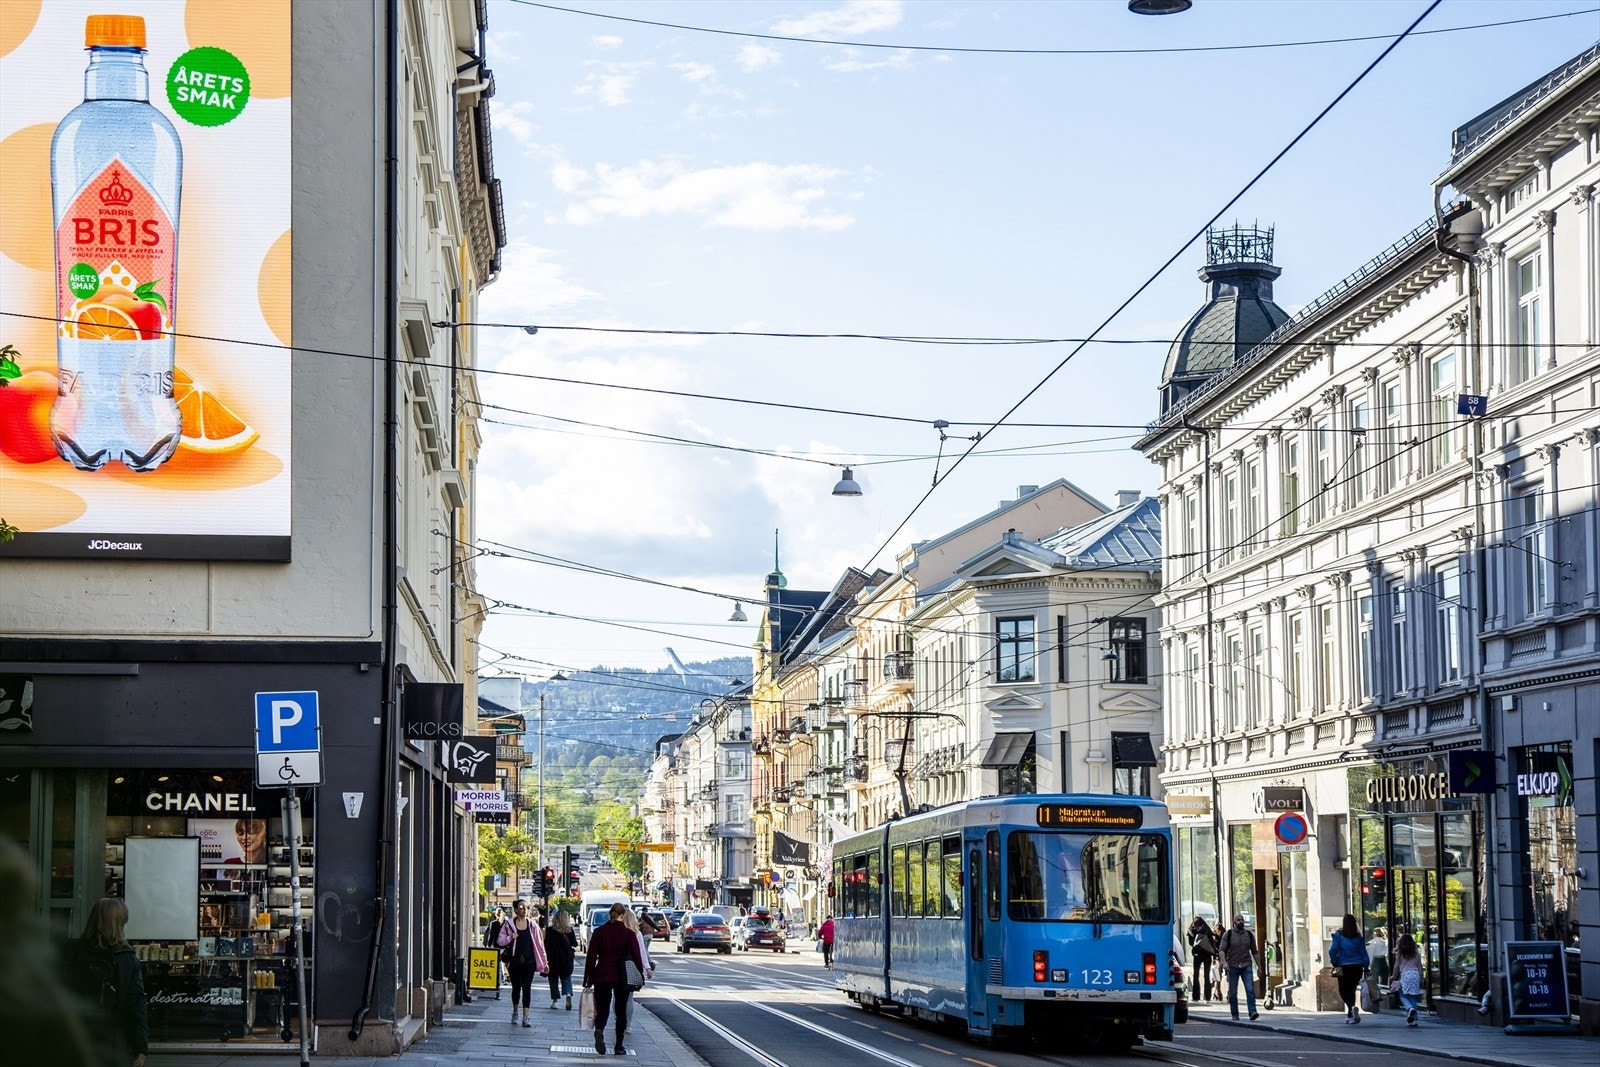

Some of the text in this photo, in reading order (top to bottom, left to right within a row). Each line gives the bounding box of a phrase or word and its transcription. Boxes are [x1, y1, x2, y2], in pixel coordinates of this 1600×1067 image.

[174, 66, 244, 93] ÅRETS
[176, 87, 236, 110] SMAK
[72, 217, 160, 246] BRIS
[70, 273, 97, 283] ÅRETS
[72, 282, 95, 290] SMAK
[1467, 397, 1479, 405] 58
[1469, 406, 1476, 415] V
[88, 540, 143, 550] JCDecaux
[271, 700, 303, 744] P
[408, 722, 460, 736] KICKS
[1366, 773, 1457, 804] GULLBORGE
[461, 792, 500, 800] MORRIS
[146, 793, 256, 811] CHANEL
[1187, 801, 1207, 809] BOK
[1268, 800, 1301, 808] VOLT
[473, 958, 495, 969] SALE
[474, 971, 493, 981] 70%
[1081, 969, 1112, 985] 123
[1526, 969, 1547, 978] 10-19
[1528, 985, 1550, 995] 10-18
[150, 989, 236, 1004] destination
